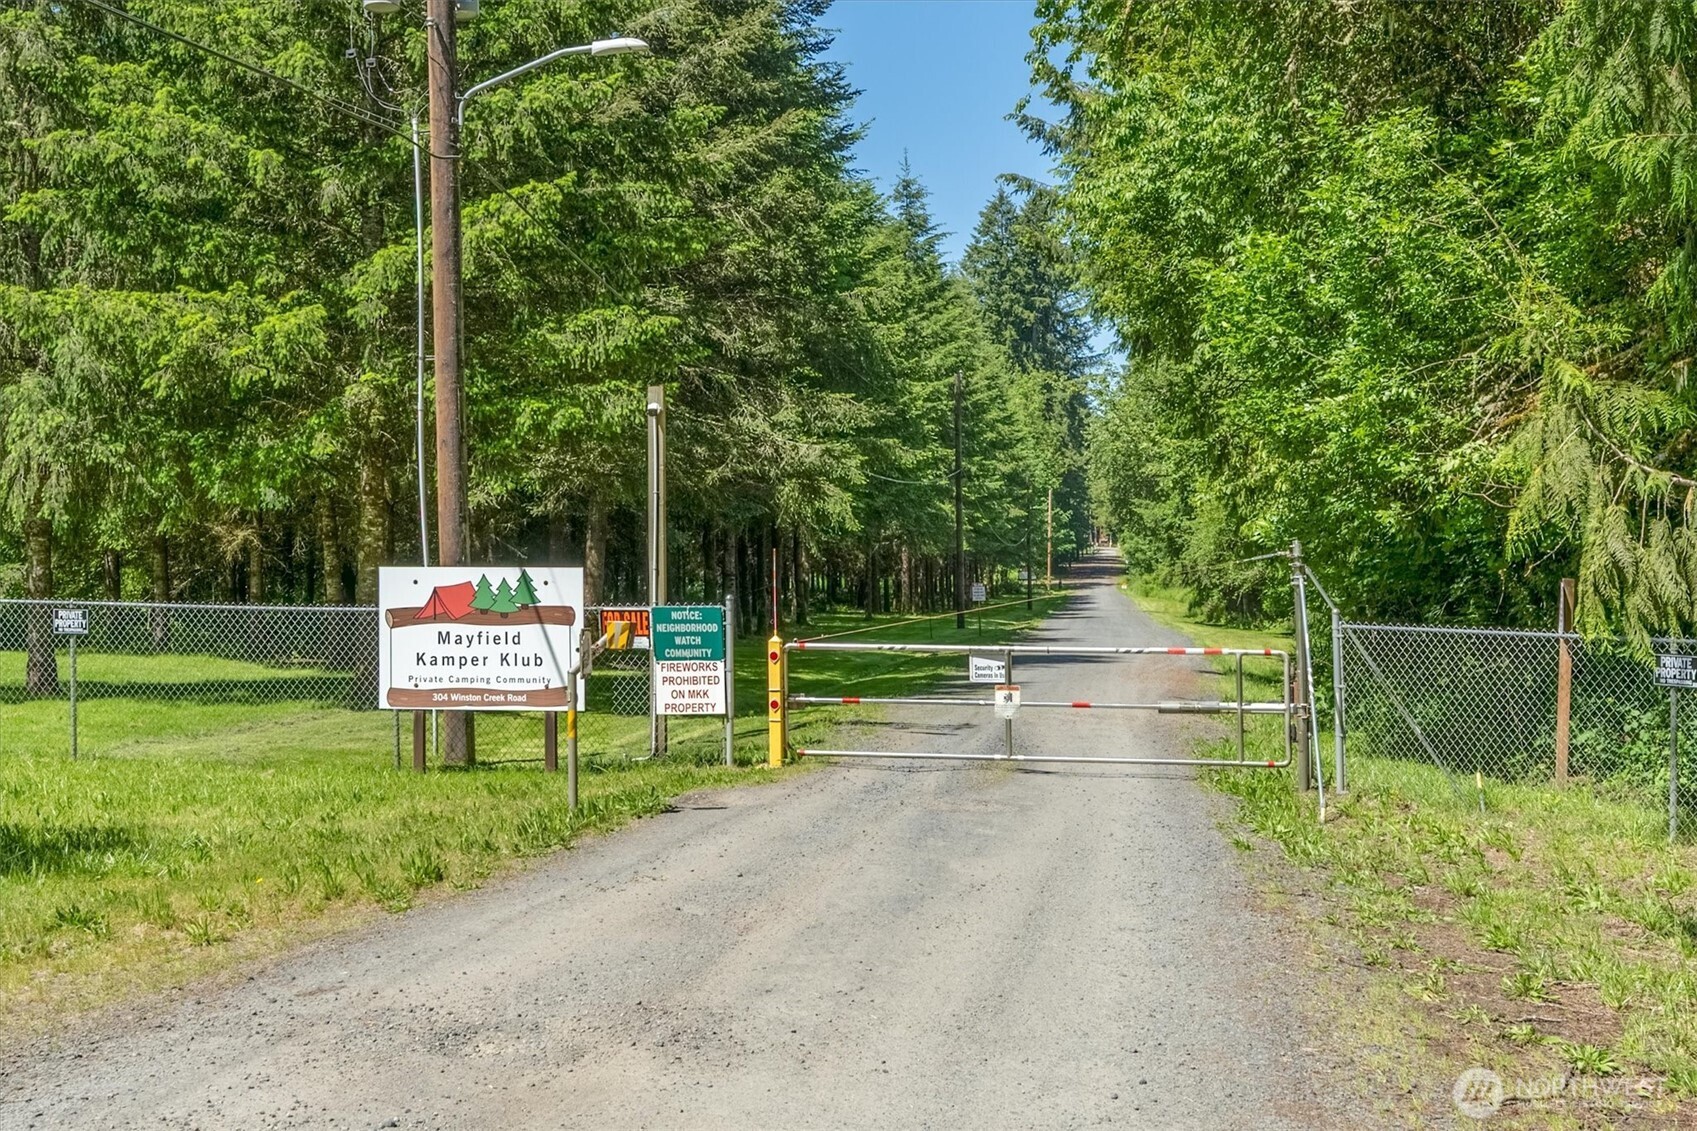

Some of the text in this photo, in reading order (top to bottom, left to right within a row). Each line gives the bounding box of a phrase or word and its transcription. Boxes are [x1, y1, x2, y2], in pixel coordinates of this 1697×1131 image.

[58, 610, 83, 620] PRIVATE
[671, 611, 703, 620] NOTICE:
[55, 619, 87, 628] PROPERTY
[656, 623, 718, 633] NEIGHBORHOOD
[437, 631, 522, 648] Mayfield
[674, 636, 702, 645] WATCH
[665, 648, 712, 658] COMMUNITY
[416, 652, 544, 669] Kamper Klub
[1660, 656, 1692, 669] PRIVATE
[661, 662, 718, 672] FIREWORKS
[974, 664, 993, 672] Security
[1655, 668, 1697, 680] PROPERTY
[408, 675, 552, 686] Private Camping Community
[662, 675, 720, 686] PROHIBITED
[432, 693, 527, 702] 304 Winston Creek Road
[671, 689, 710, 699] ON MKK
[664, 703, 717, 713] PROPERTY
